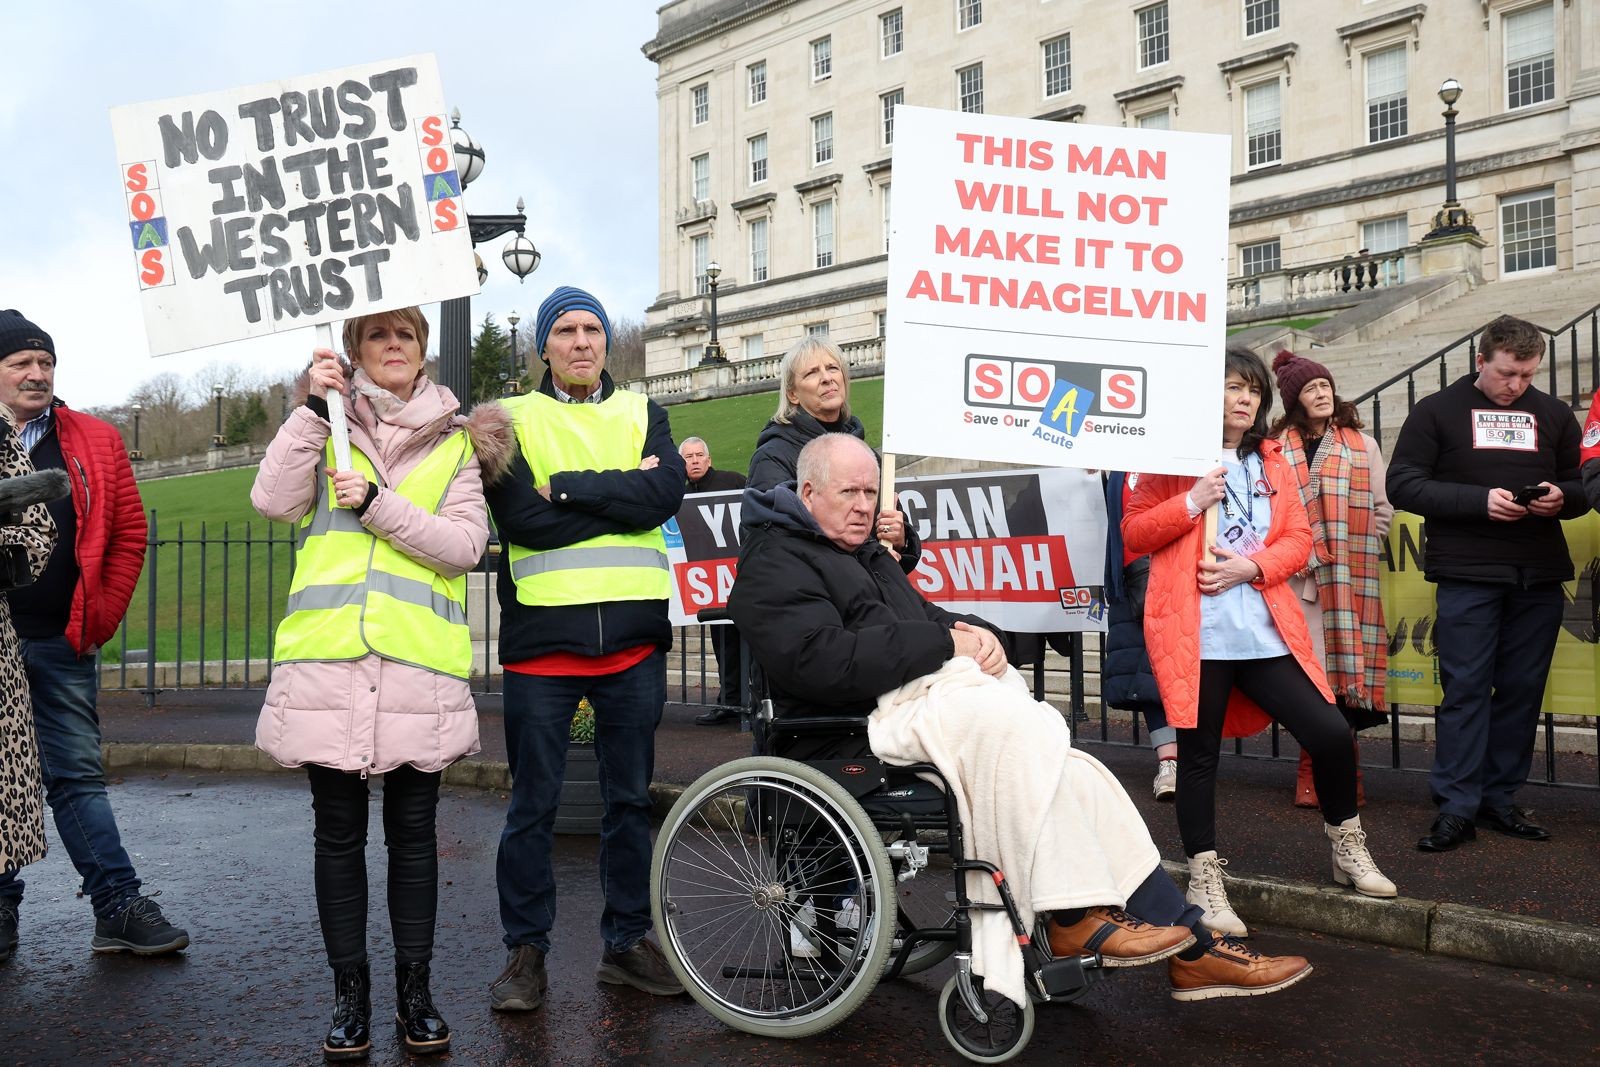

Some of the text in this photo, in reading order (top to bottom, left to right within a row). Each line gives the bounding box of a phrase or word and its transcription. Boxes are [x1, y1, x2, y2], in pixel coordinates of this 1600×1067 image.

[159, 67, 418, 169] NO TRUST
[208, 137, 393, 215] IN THE
[956, 133, 1167, 180] THIS MAN
[954, 179, 1168, 226] WILL NOT
[177, 182, 421, 279] WESTERN
[935, 224, 1184, 274] MAKE IT TO
[224, 249, 390, 323] TRUST
[906, 270, 1207, 323] ALTNAGELVIN
[963, 411, 1146, 450] Save Our Acute Services
[898, 485, 1011, 541] CAN
[916, 543, 1056, 593] SWAH
